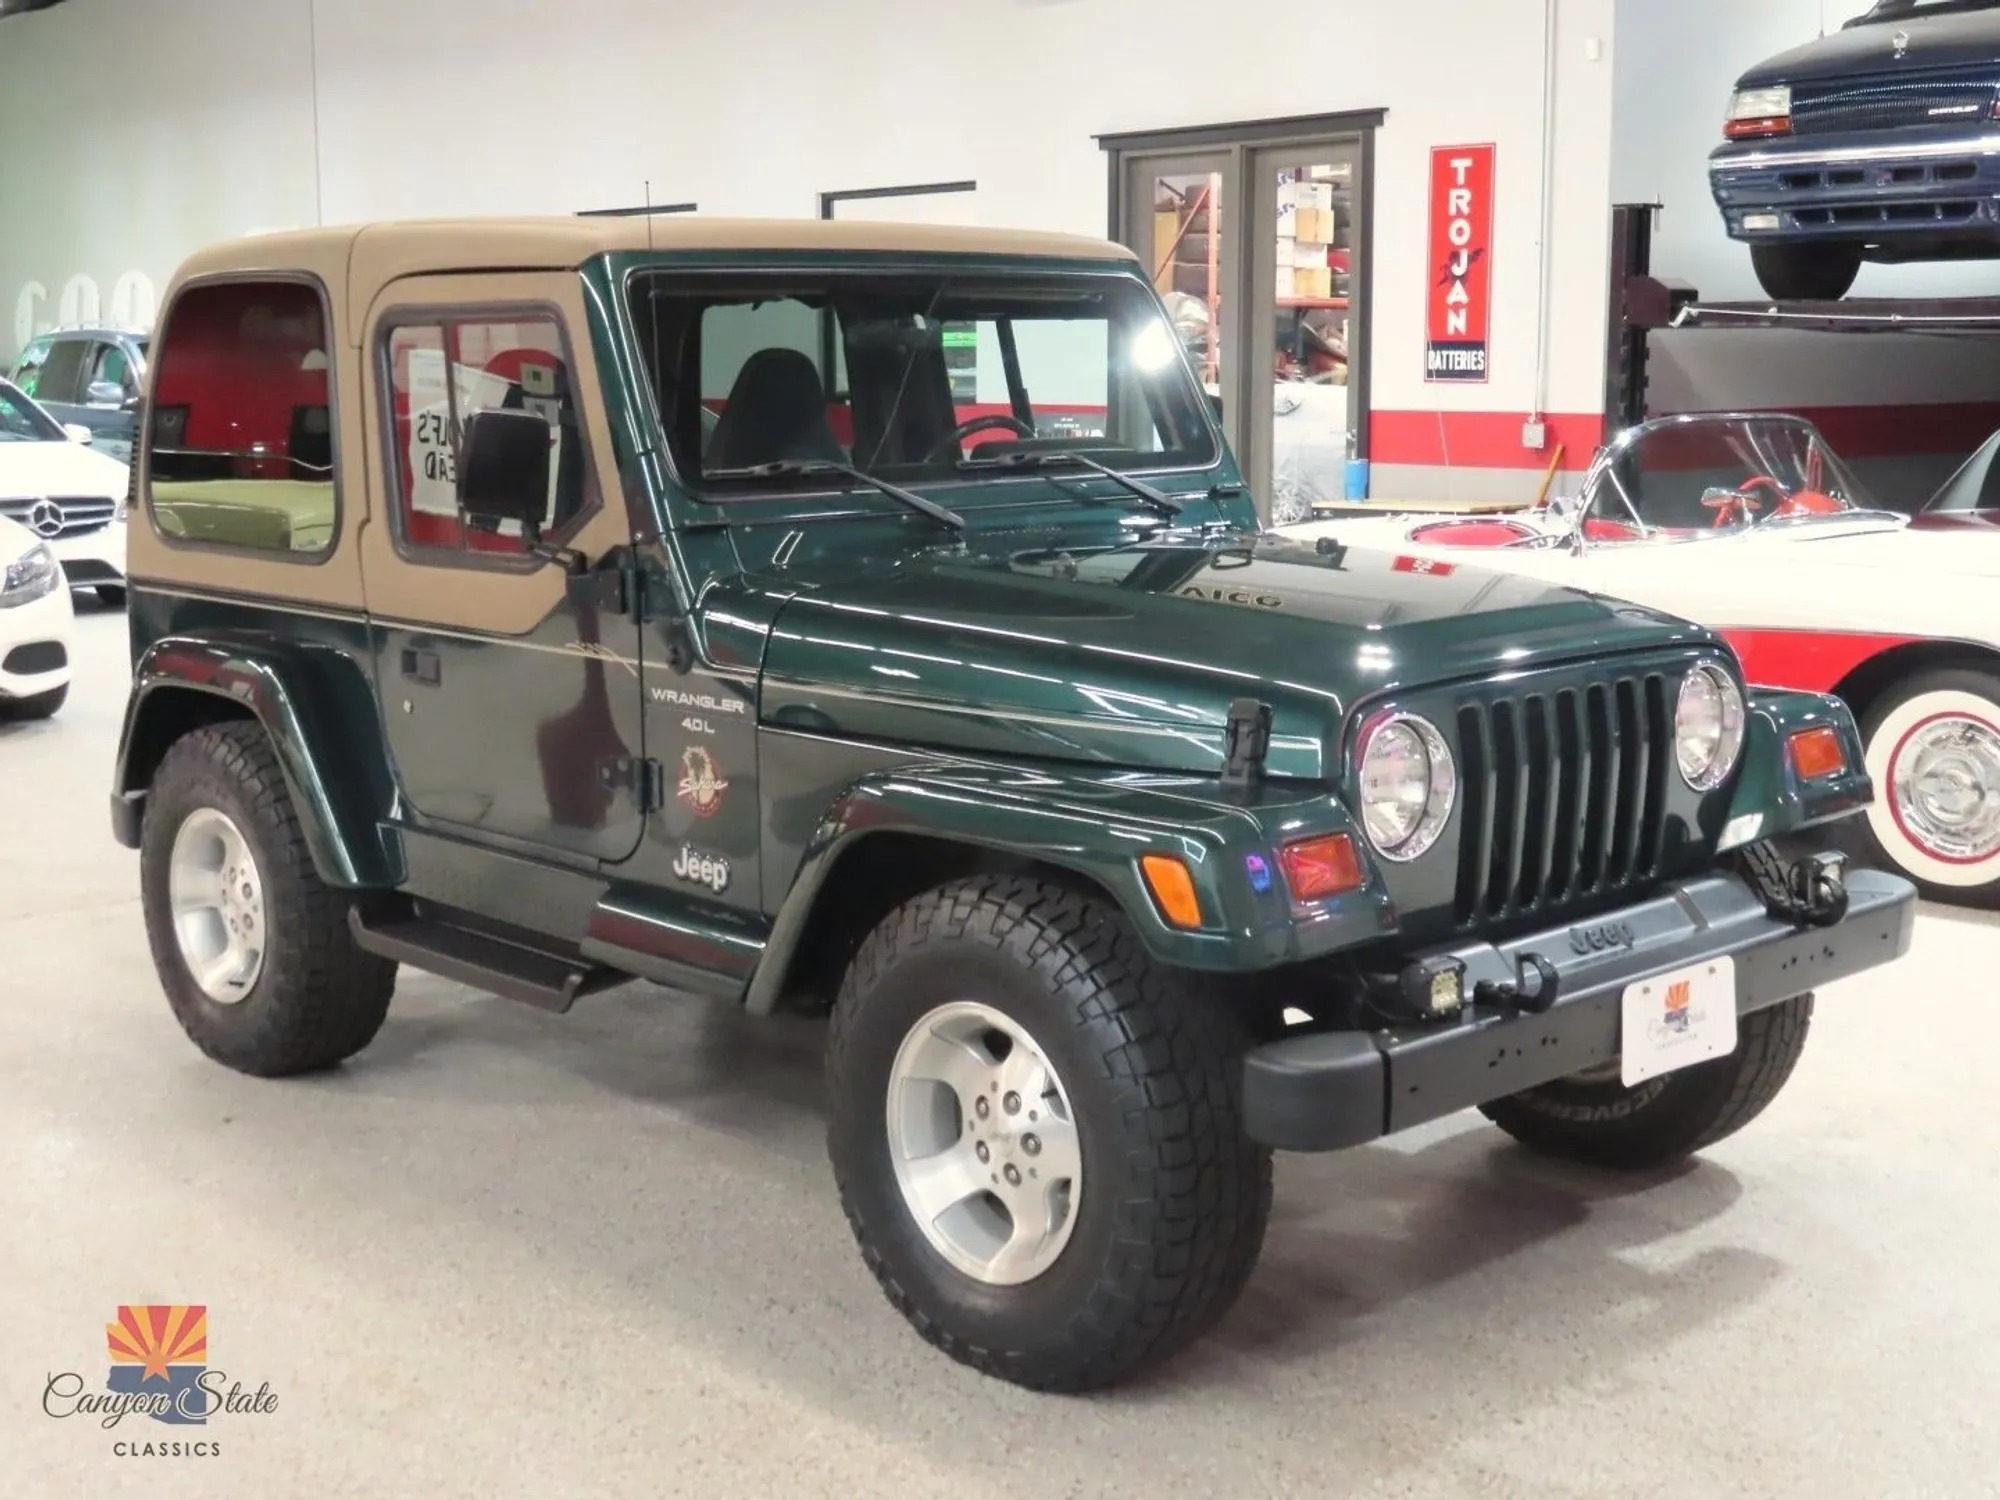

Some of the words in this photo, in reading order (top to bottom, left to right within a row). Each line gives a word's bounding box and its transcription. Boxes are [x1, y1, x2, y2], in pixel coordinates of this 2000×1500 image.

[1446, 157, 1474, 335] TROJAN
[1428, 349, 1485, 371] BATTERIES
[651, 687, 745, 715] WRANGLER
[672, 847, 728, 891] Jeep
[1568, 922, 1635, 956] Jeep
